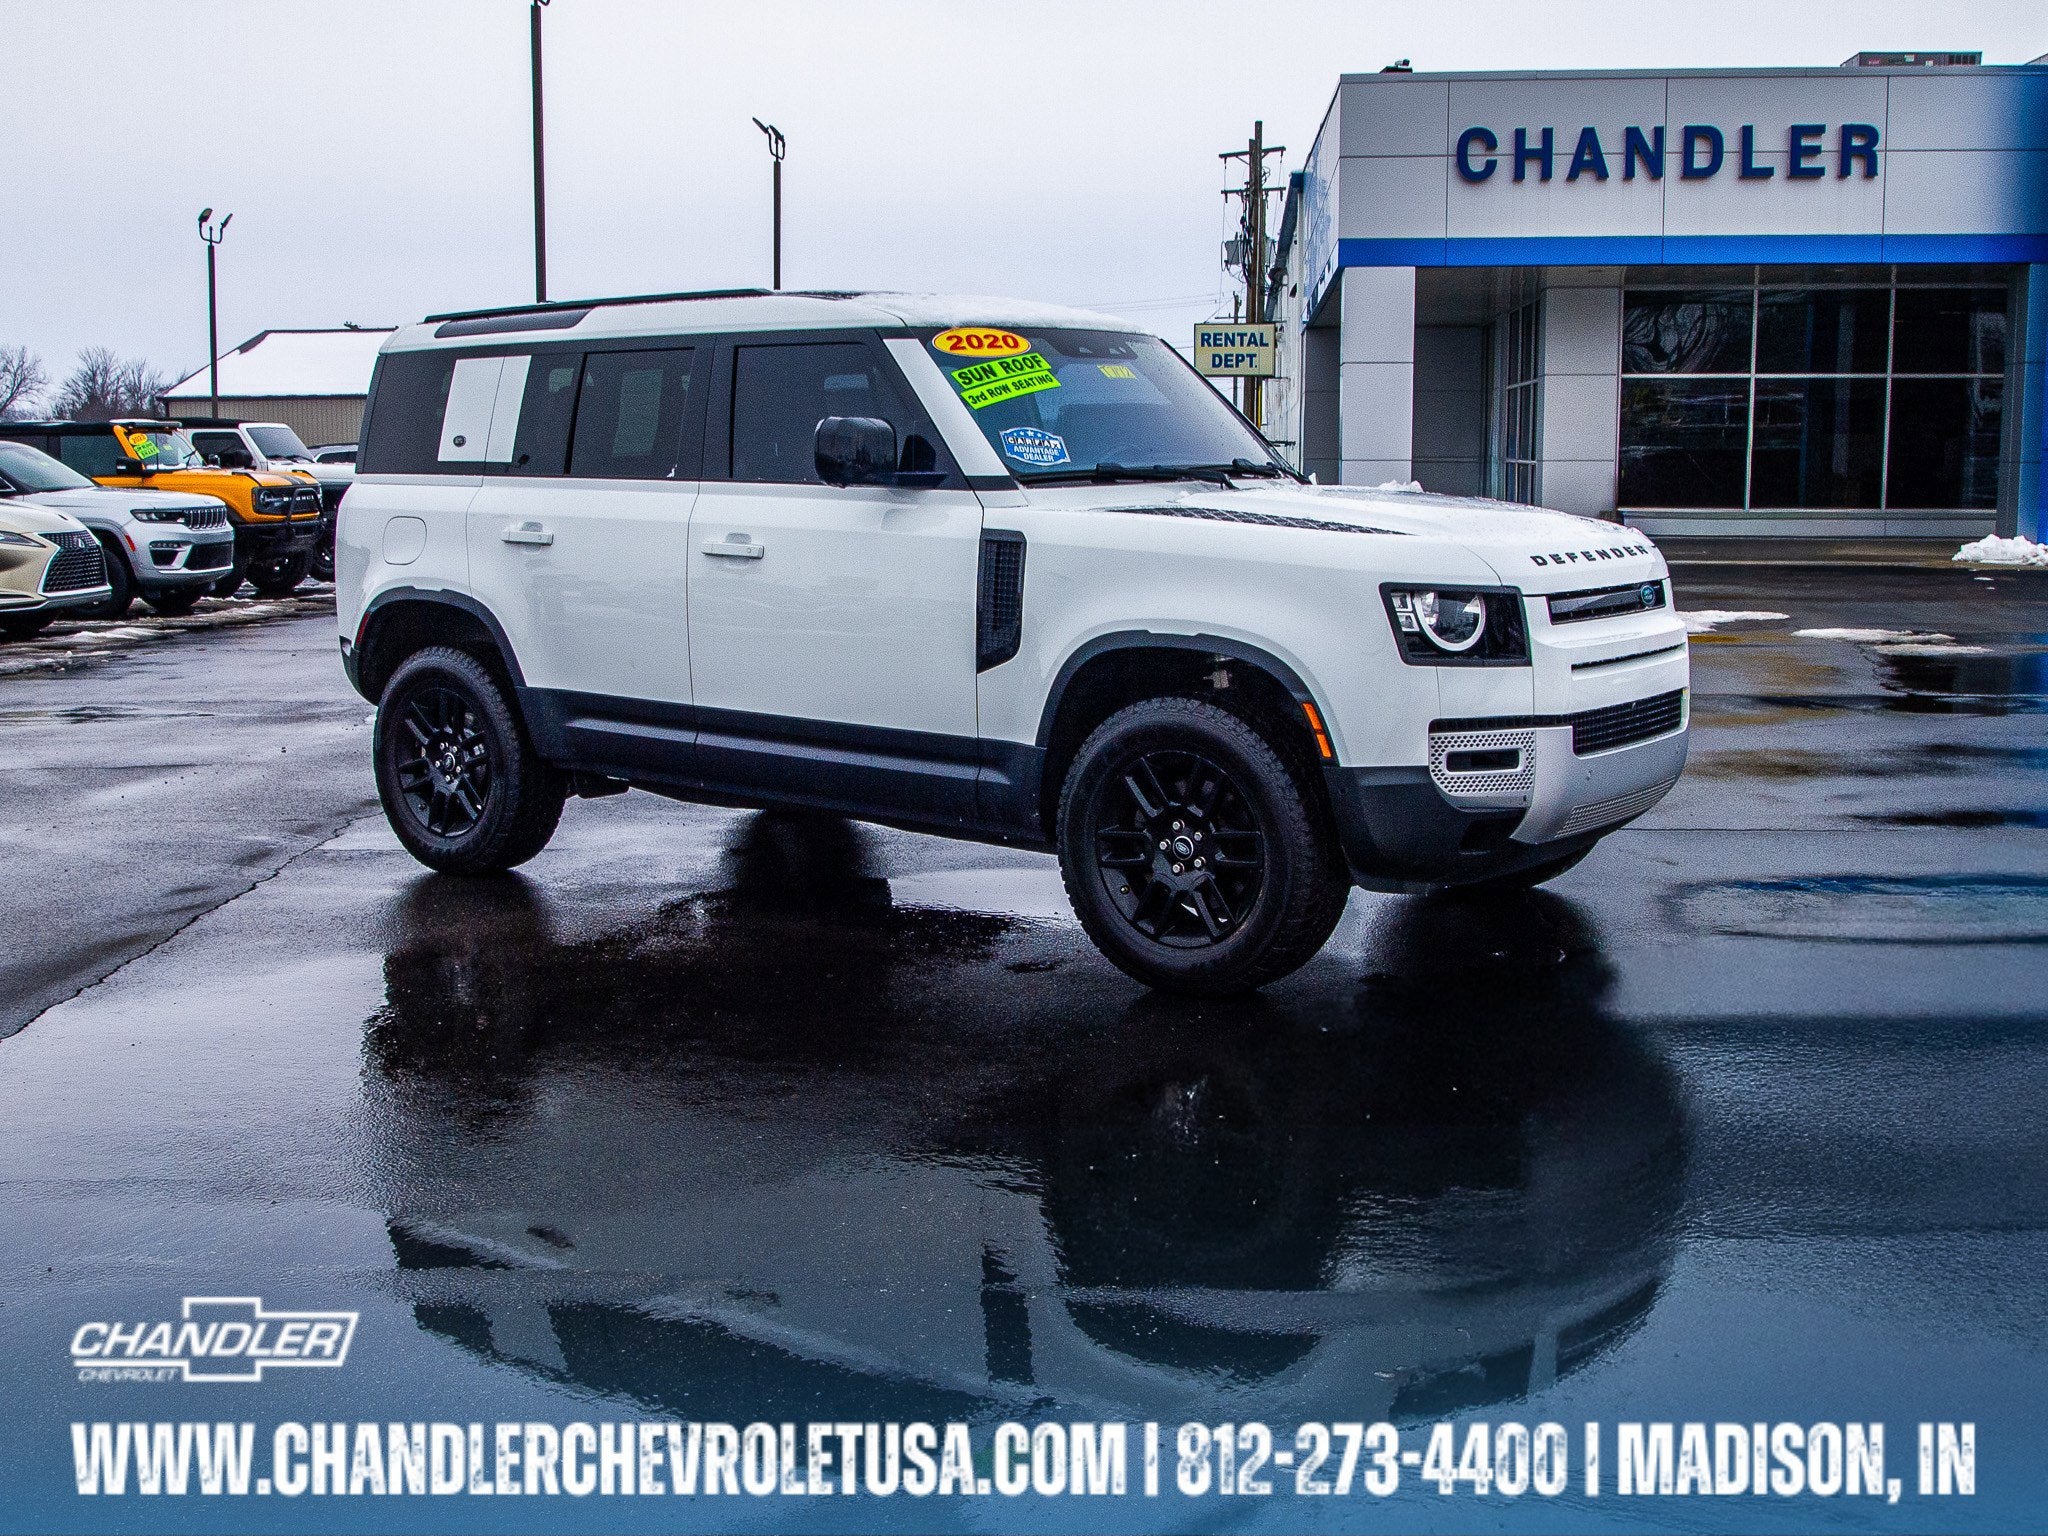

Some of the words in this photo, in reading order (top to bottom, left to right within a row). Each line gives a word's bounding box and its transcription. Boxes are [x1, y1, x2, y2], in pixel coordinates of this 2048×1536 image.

[1456, 123, 1880, 182] CHANDLER
[946, 334, 1019, 351] 2020
[1200, 332, 1269, 348] RENTAL
[1211, 353, 1258, 369] DEPT.
[957, 364, 998, 386] SUN
[998, 354, 1043, 375] ROOF
[967, 390, 988, 405] 3rd
[987, 383, 1012, 399] ROW
[1011, 374, 1054, 391] SEATING
[1006, 436, 1061, 450] CARFAX
[1013, 445, 1060, 457] ADVANTAGE
[1023, 452, 1055, 462] DEALER
[1530, 544, 1649, 567] DEFENDER
